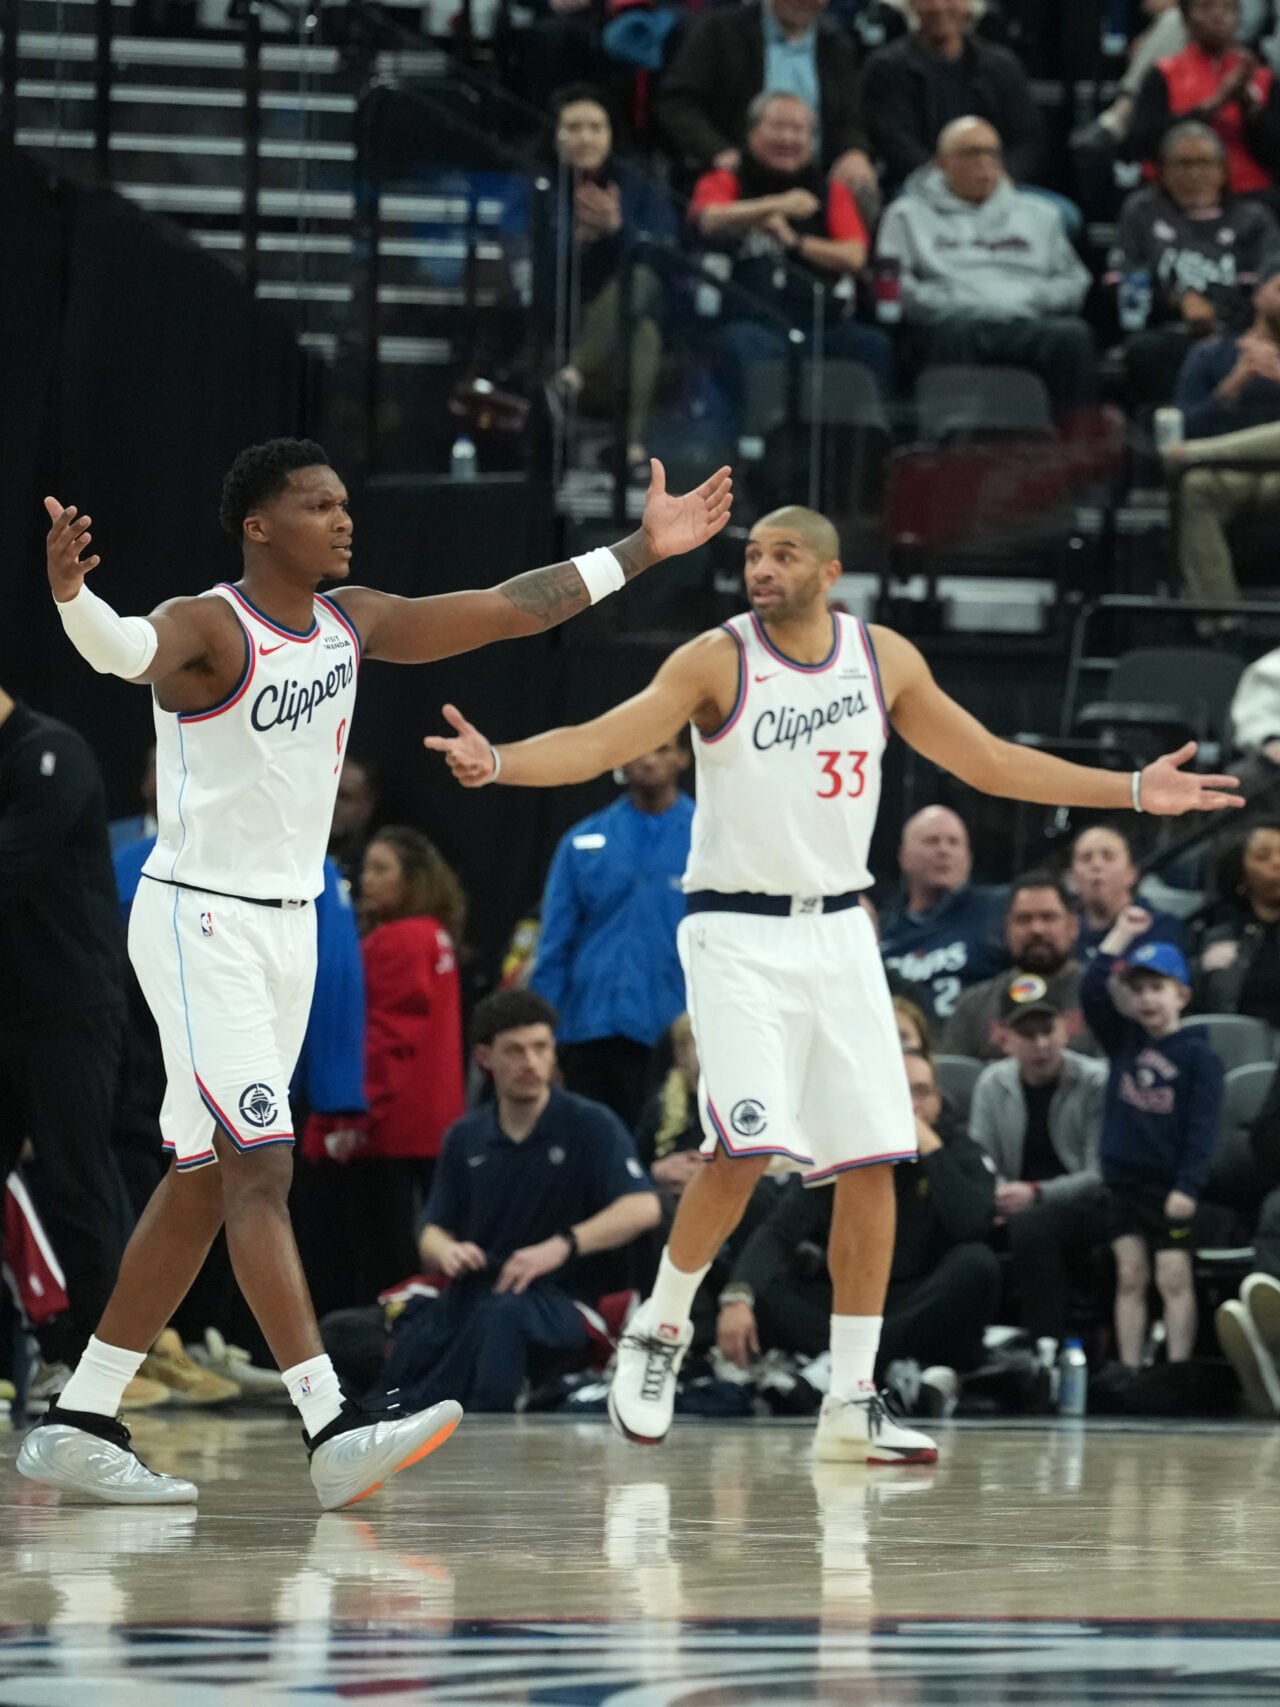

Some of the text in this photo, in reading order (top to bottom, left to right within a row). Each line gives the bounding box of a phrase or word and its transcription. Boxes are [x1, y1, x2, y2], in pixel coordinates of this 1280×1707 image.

[251, 655, 353, 732] Clippers
[752, 690, 869, 751] Clippers
[816, 750, 869, 799] 33
[932, 976, 961, 1018] 2
